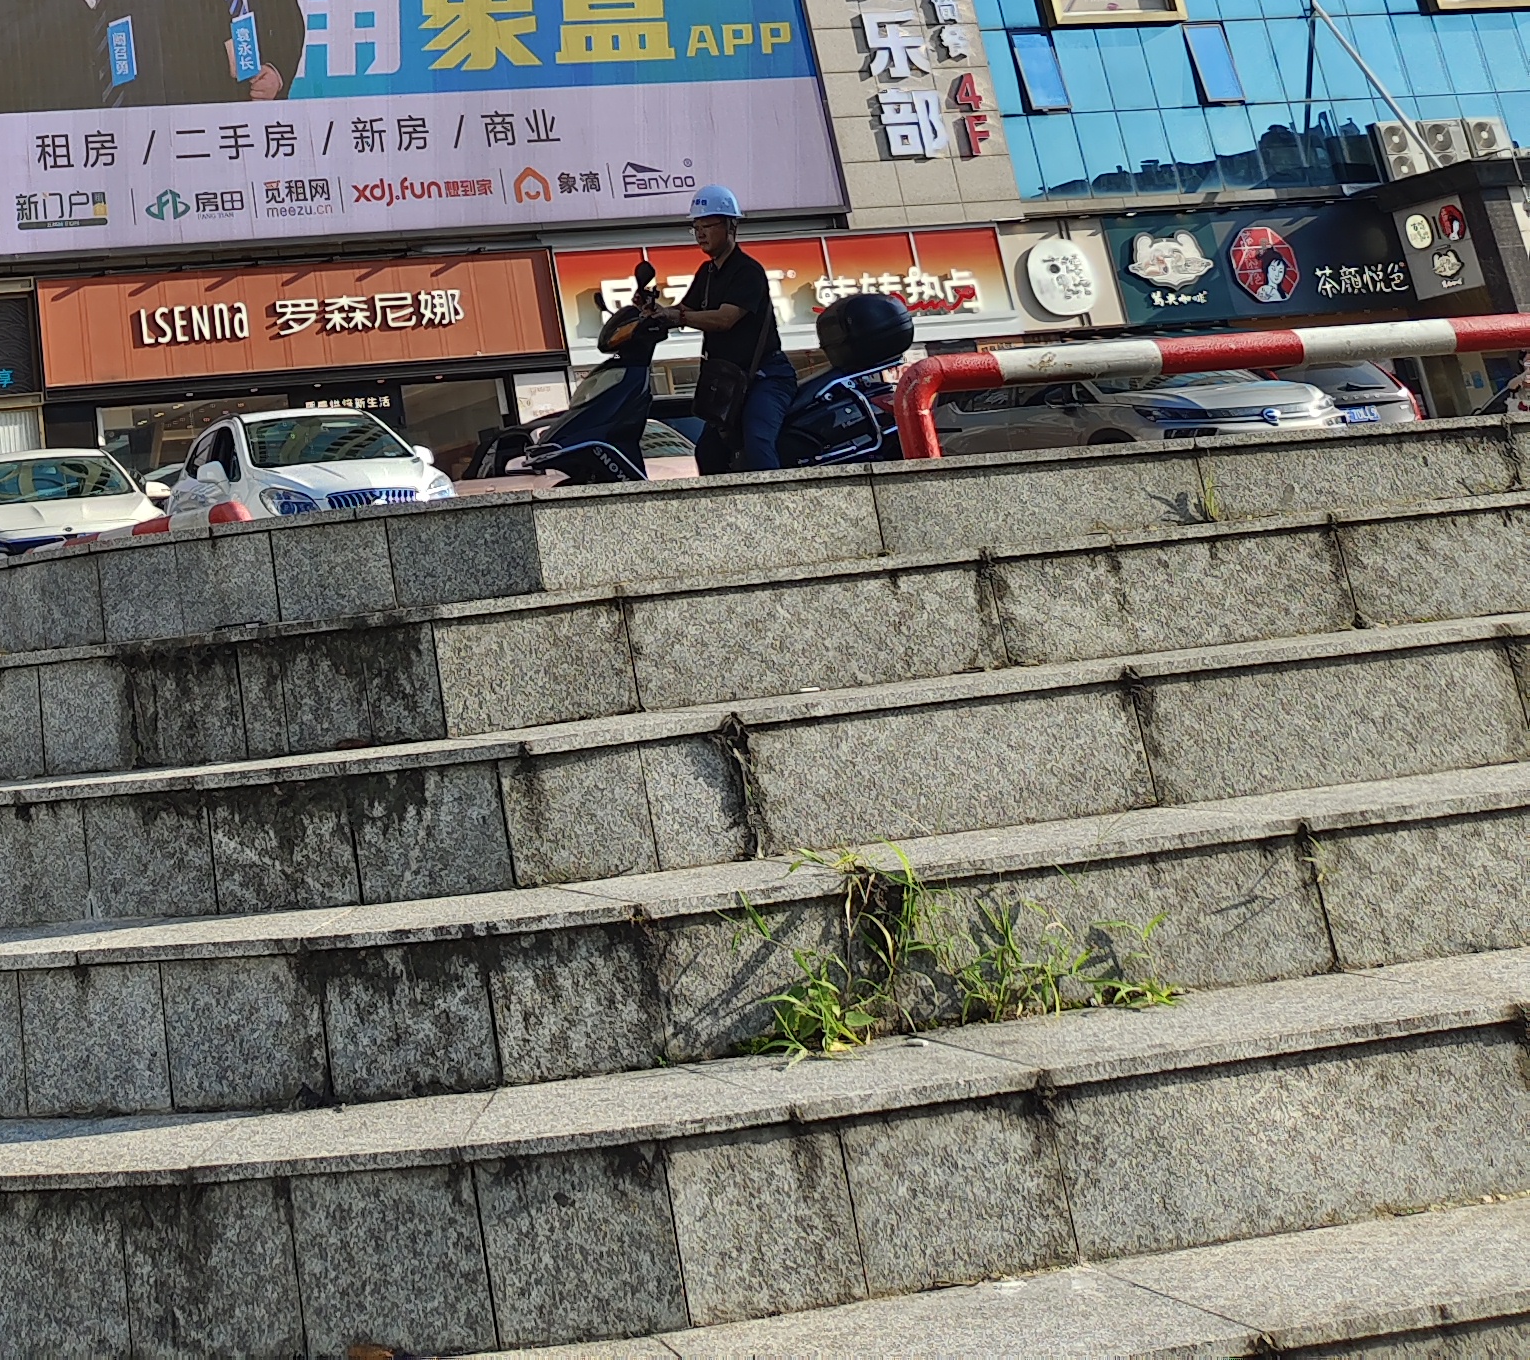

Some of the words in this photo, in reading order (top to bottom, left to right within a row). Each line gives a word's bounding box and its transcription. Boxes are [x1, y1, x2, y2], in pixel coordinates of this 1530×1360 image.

[956, 73, 990, 155] 4F
[264, 178, 330, 204] 觅租网
[558, 170, 601, 194] 象滴
[16, 191, 90, 222] 新门户
[195, 190, 244, 213] 房田
[266, 204, 333, 218] meezu.cn
[1315, 263, 1409, 298] 茶颜悦色
[275, 289, 464, 337] 罗森尼娜
